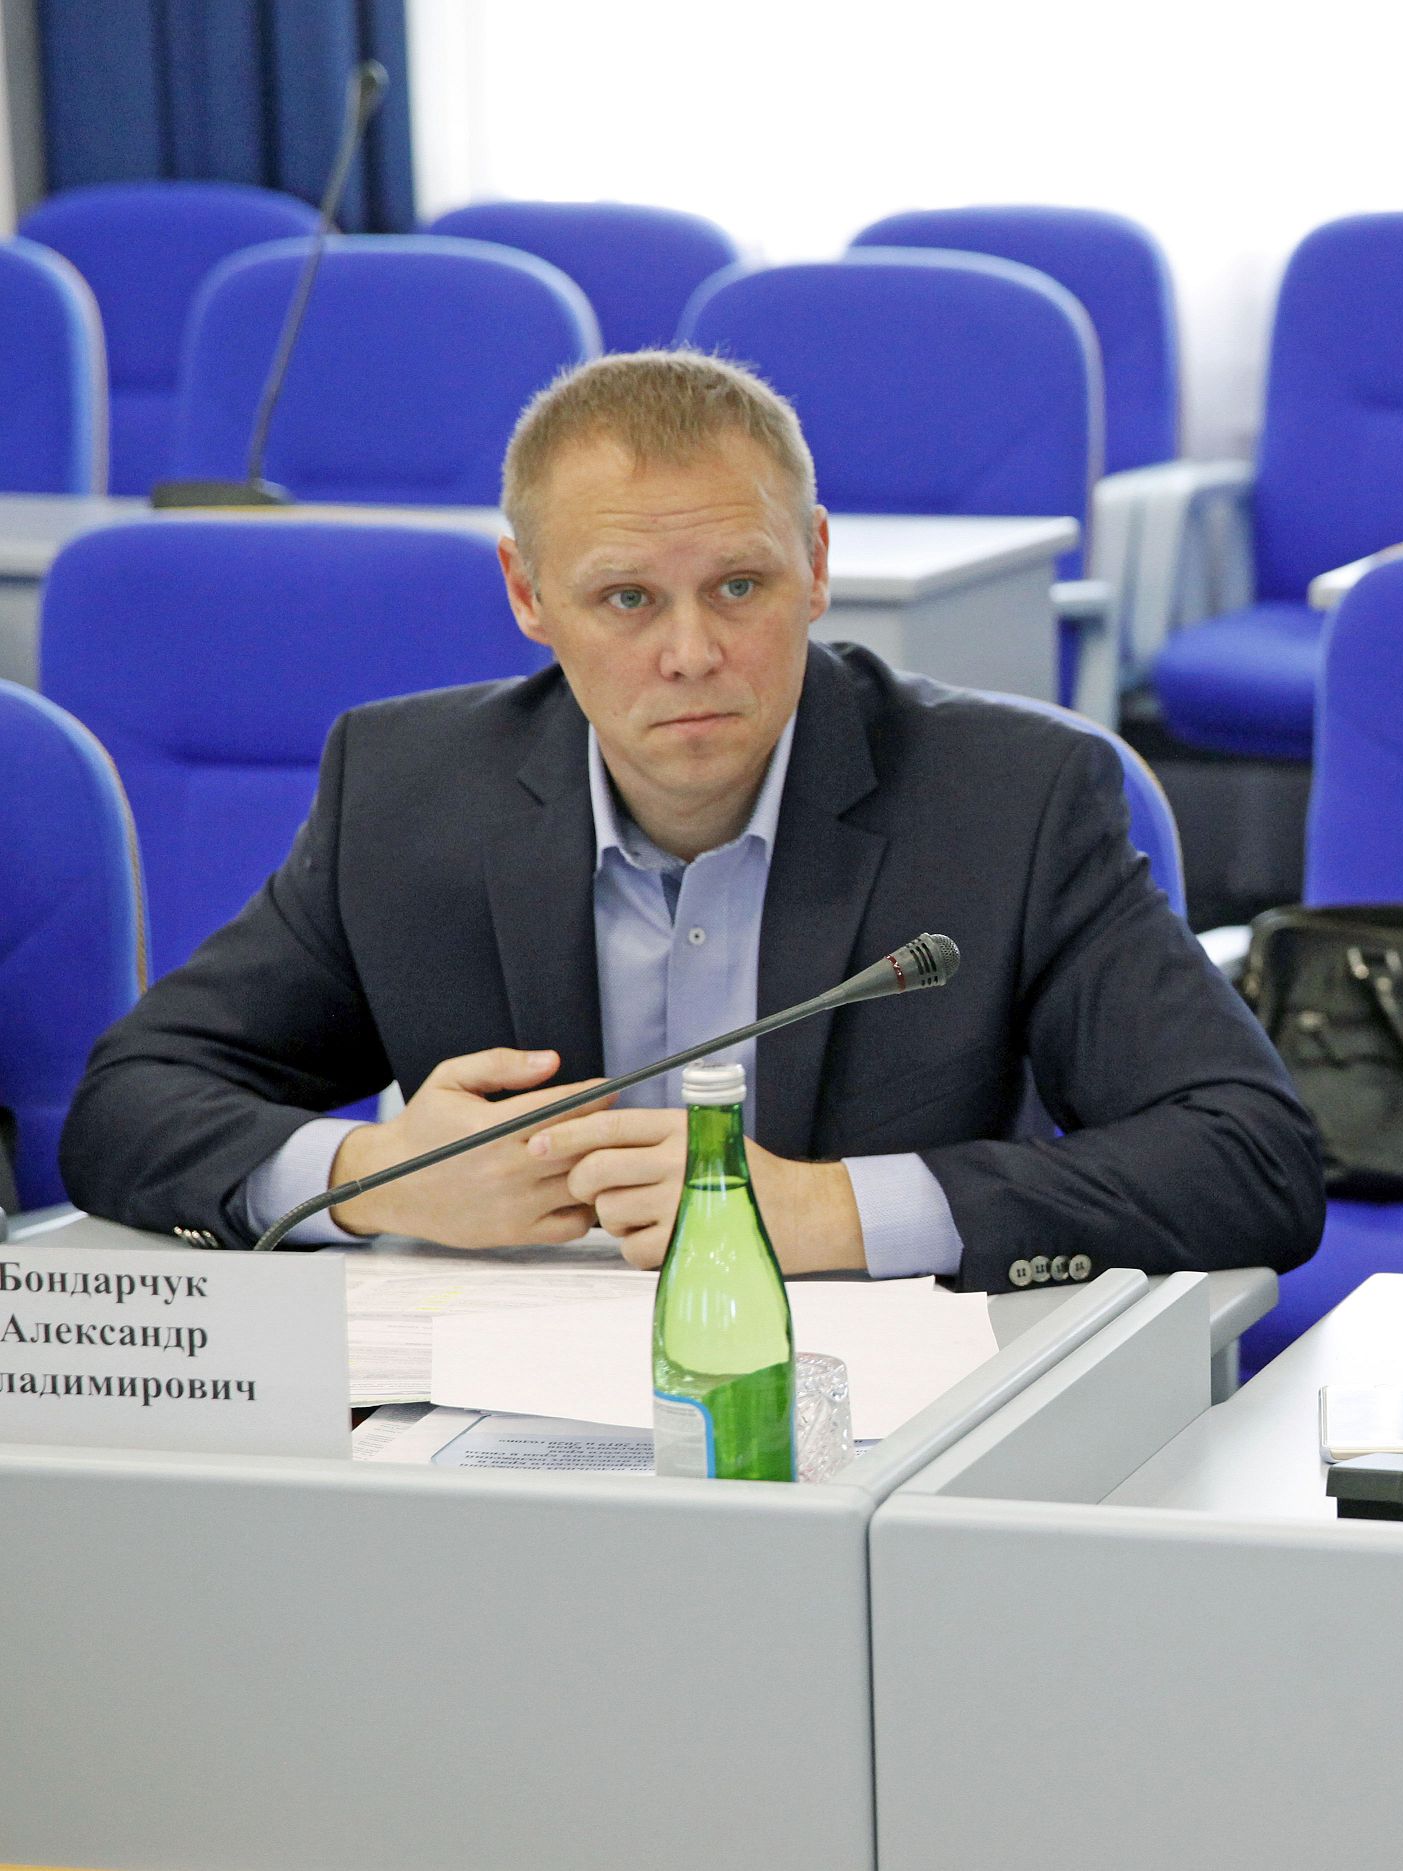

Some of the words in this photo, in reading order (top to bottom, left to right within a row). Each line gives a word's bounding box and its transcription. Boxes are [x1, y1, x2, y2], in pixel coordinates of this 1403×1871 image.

[0, 1262, 208, 1305] Бондарчук
[1, 1313, 208, 1357] Александр
[0, 1371, 257, 1407] ладимирович
